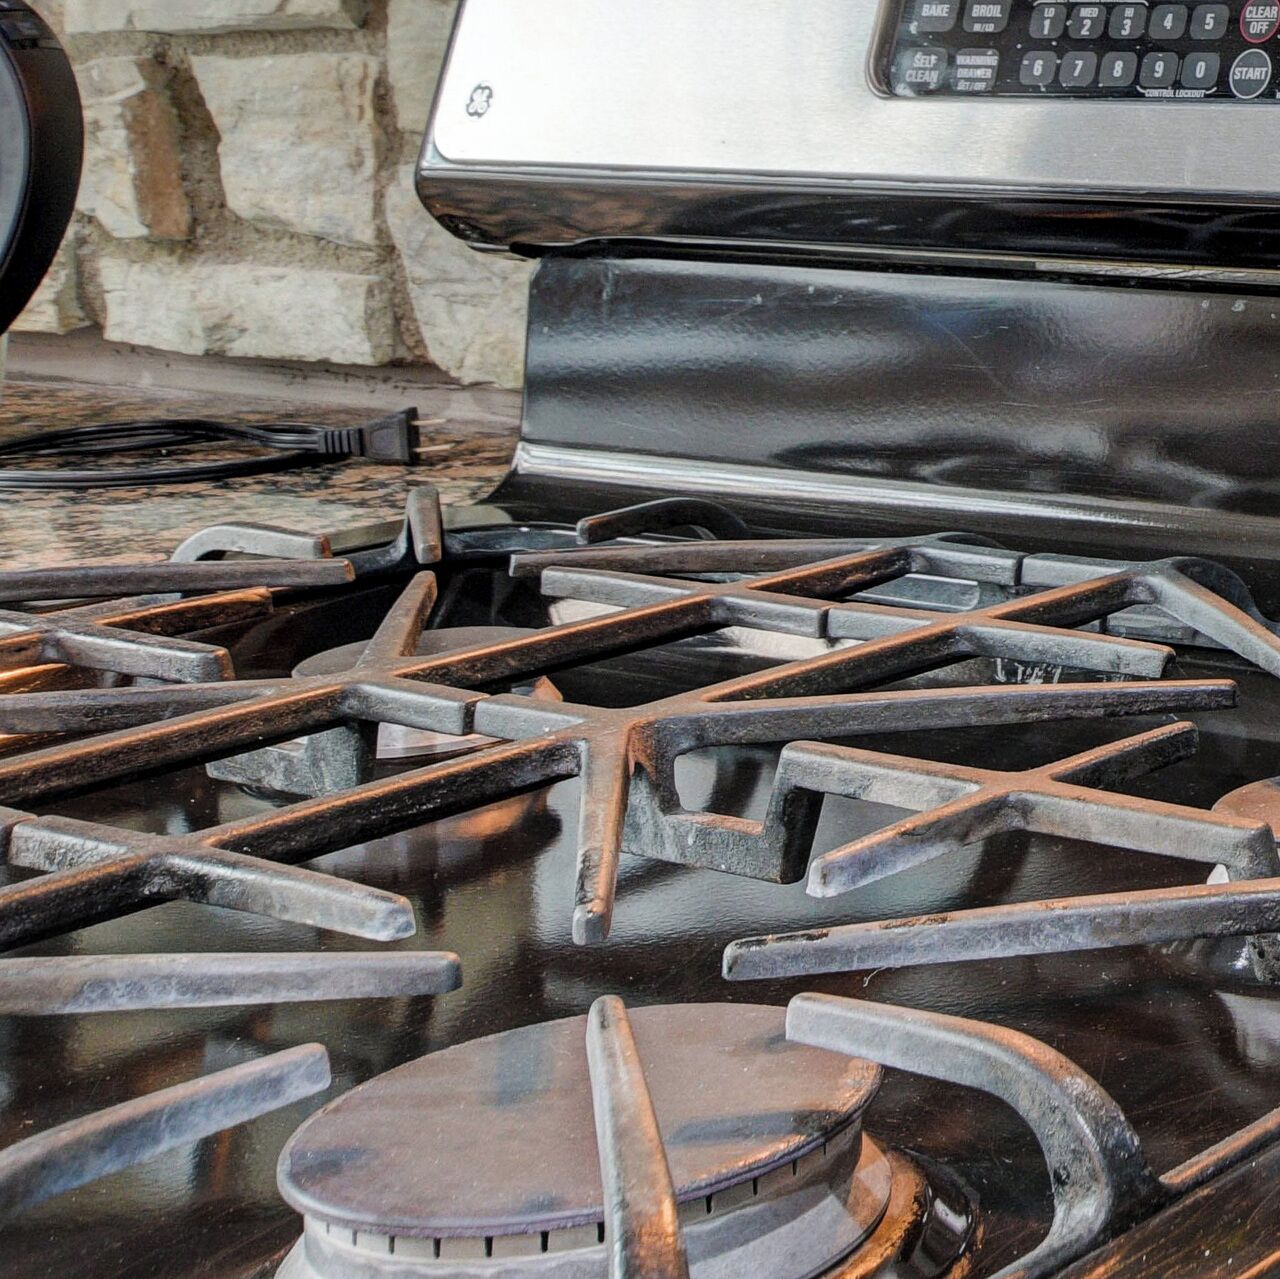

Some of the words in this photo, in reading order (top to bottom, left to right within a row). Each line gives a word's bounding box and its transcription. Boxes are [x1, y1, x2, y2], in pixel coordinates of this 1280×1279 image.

[921, 4, 951, 17] BAKE
[971, 4, 1003, 17] BROIL
[1044, 7, 1055, 17] LO
[1079, 7, 1099, 18] MED
[1124, 7, 1135, 17] HI
[1245, 6, 1278, 18] CLEAR
[1043, 19, 1051, 35] 1
[1080, 19, 1092, 35] 2
[1120, 19, 1132, 36] 3
[1163, 14, 1174, 30] 4
[1204, 14, 1215, 30] 5
[1249, 21, 1269, 34] OFF
[913, 53, 938, 67] SELF
[956, 68, 992, 78] DRAWER
[1032, 60, 1043, 76] 6
[1074, 60, 1084, 76] 7
[1112, 61, 1123, 77] 8
[1153, 61, 1164, 77] 9
[1195, 61, 1206, 78] 0
[1233, 67, 1268, 80] START
[905, 70, 939, 82] CLEAN
[1145, 89, 1174, 97] CONTROL
[1175, 89, 1206, 98] LOCKOUT
